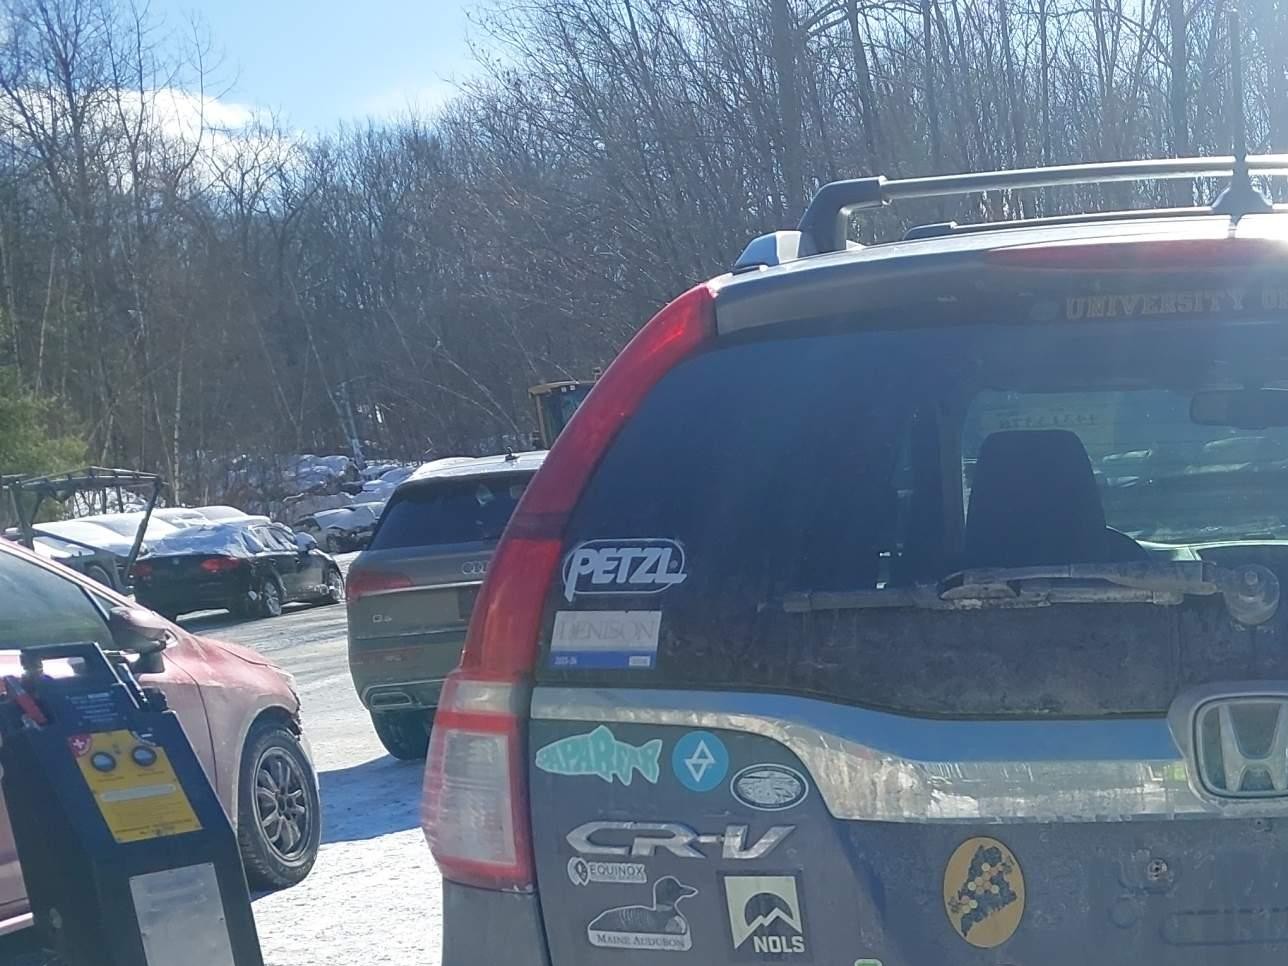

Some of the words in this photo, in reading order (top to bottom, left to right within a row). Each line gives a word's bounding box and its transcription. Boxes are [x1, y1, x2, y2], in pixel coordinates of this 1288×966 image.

[563, 547, 688, 602] PETZL
[559, 621, 657, 641] DENISON
[565, 821, 797, 859] CR-V
[590, 864, 644, 877] EQUINOX
[596, 933, 631, 946] MAINE
[632, 935, 685, 948] AUDUBON
[753, 935, 805, 954] NOLS
